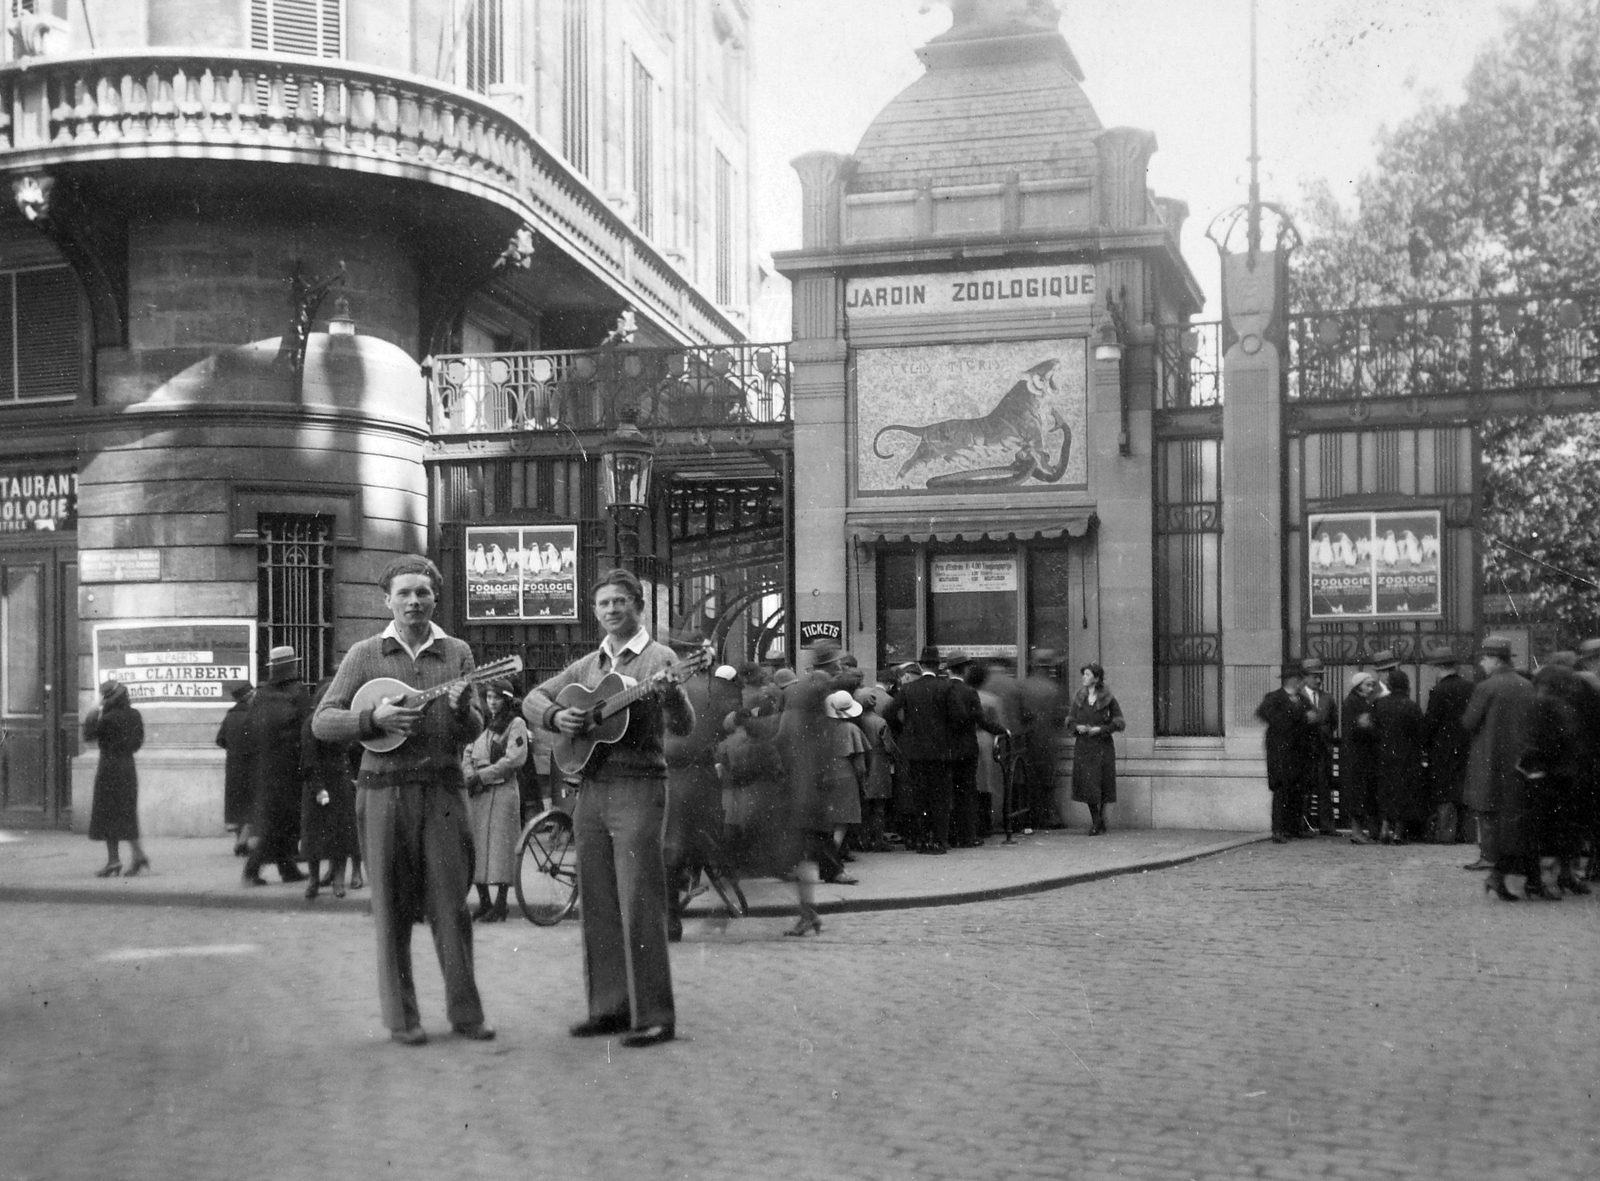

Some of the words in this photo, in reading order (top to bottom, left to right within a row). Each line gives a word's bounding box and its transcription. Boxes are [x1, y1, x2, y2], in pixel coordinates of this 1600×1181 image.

[847, 284, 926, 308] JARDIN
[952, 274, 1094, 302] ZOOLOGIQUE
[0, 498, 68, 520] OLOGIE
[1313, 577, 1371, 587] ZOOLOGIE
[1377, 575, 1437, 585] ZOOLOGIE
[469, 584, 519, 592] ZOOLOGIE
[523, 582, 573, 592] ZOOLOGIE
[802, 623, 840, 638] TICKETS
[146, 667, 242, 681] CLAIRBERT
[162, 684, 218, 697] d'Arkor
